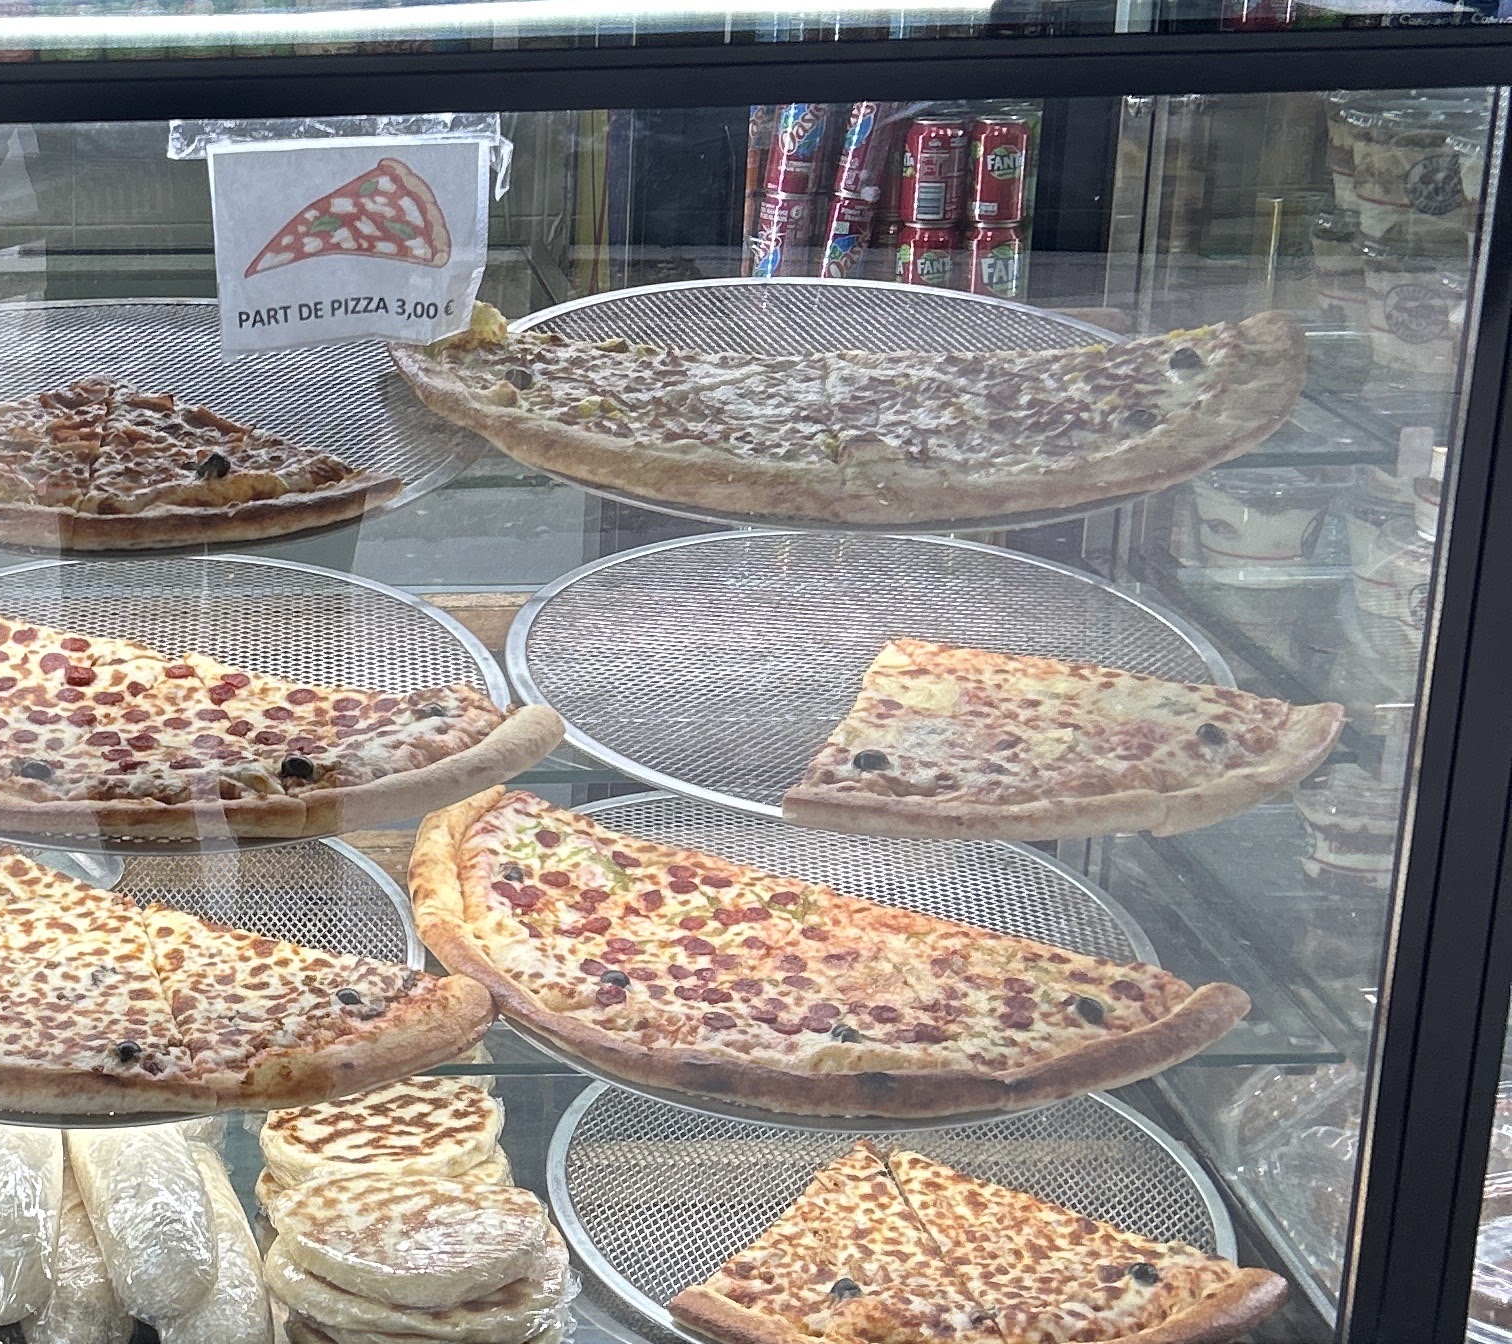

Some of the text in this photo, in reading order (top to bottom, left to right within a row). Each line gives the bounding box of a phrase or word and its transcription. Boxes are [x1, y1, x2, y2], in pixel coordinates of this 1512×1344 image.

[237, 296, 455, 330] PART DE PIZZA 3,00 €
